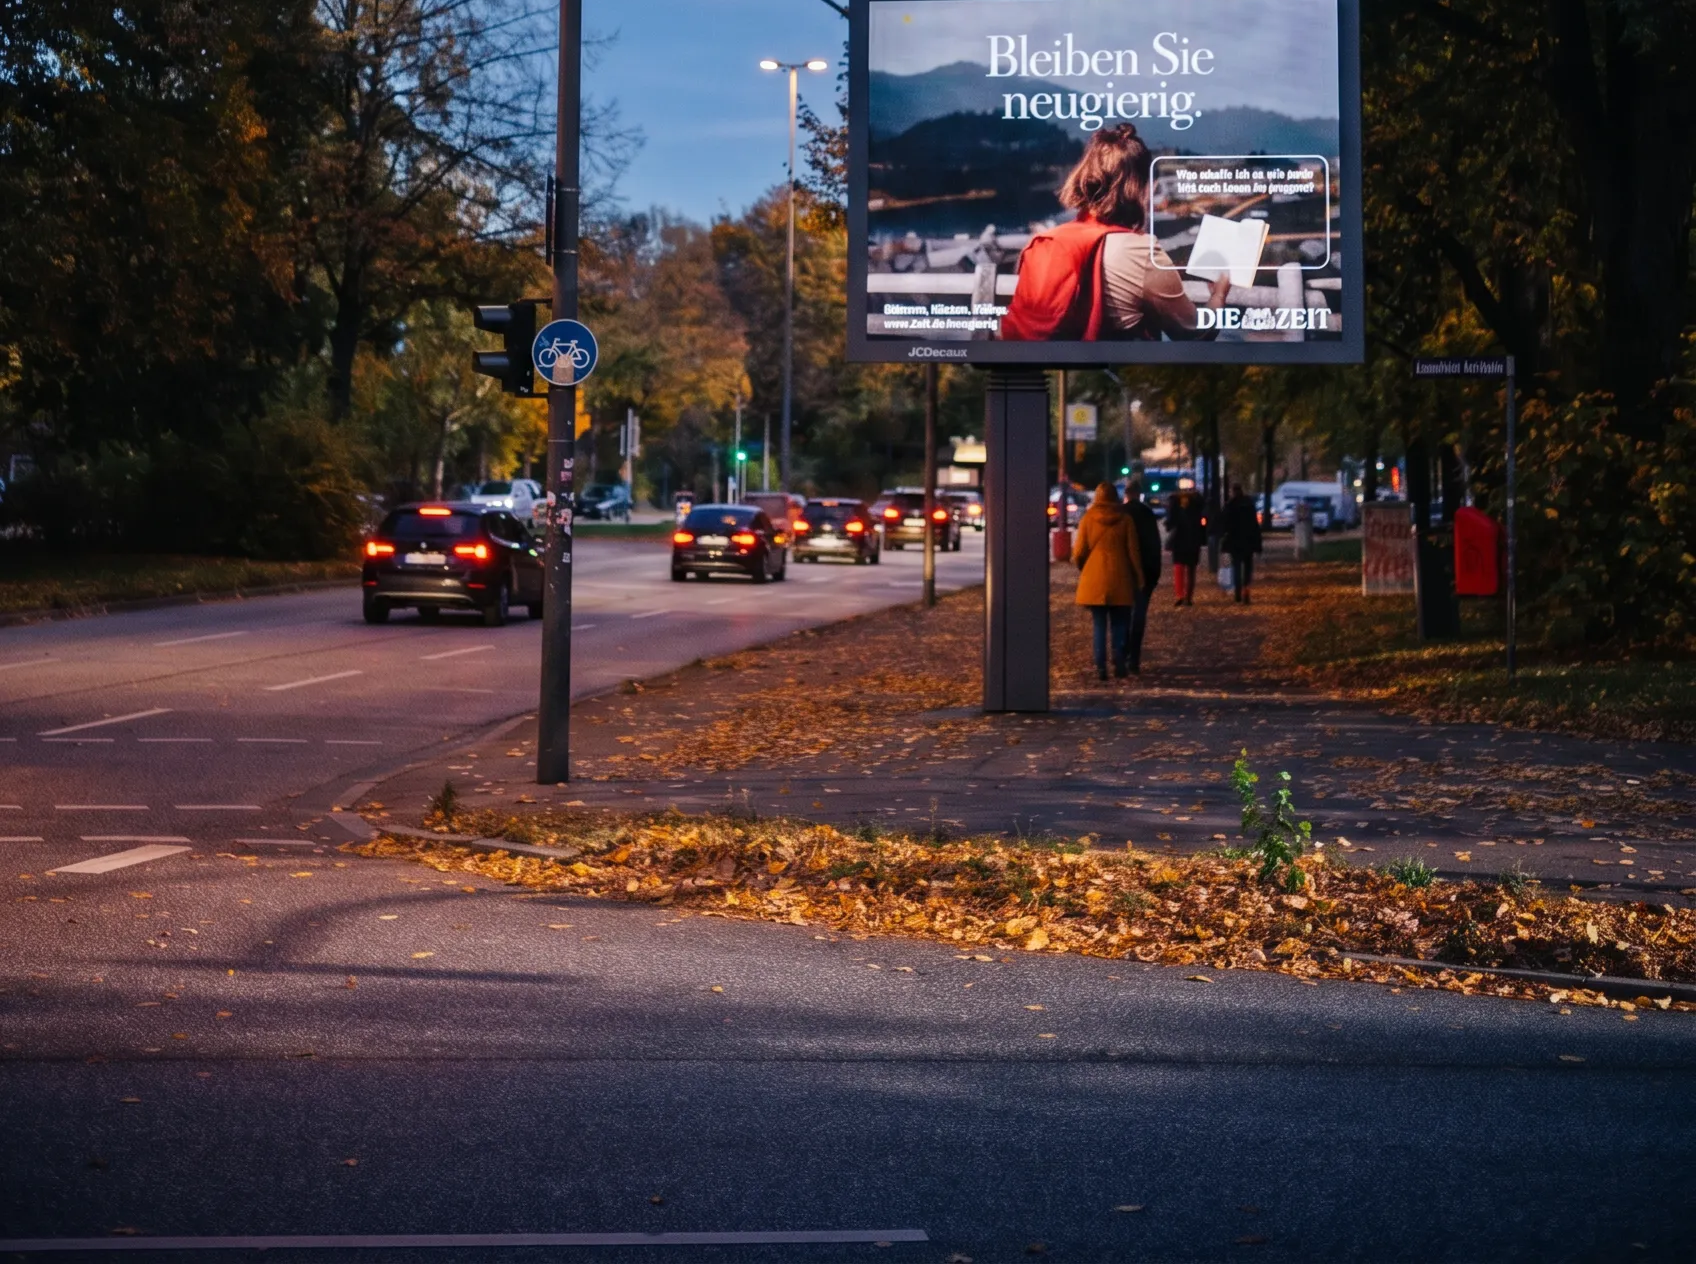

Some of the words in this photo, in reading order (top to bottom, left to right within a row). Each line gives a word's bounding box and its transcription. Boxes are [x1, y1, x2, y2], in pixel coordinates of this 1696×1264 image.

[985, 32, 1140, 77] Bleiben
[1152, 31, 1215, 76] Sie
[1001, 81, 1202, 131] neugierig.
[1196, 307, 1241, 330] DIE
[1275, 307, 1332, 330] ZEIT
[908, 346, 968, 358] JCDecaux
